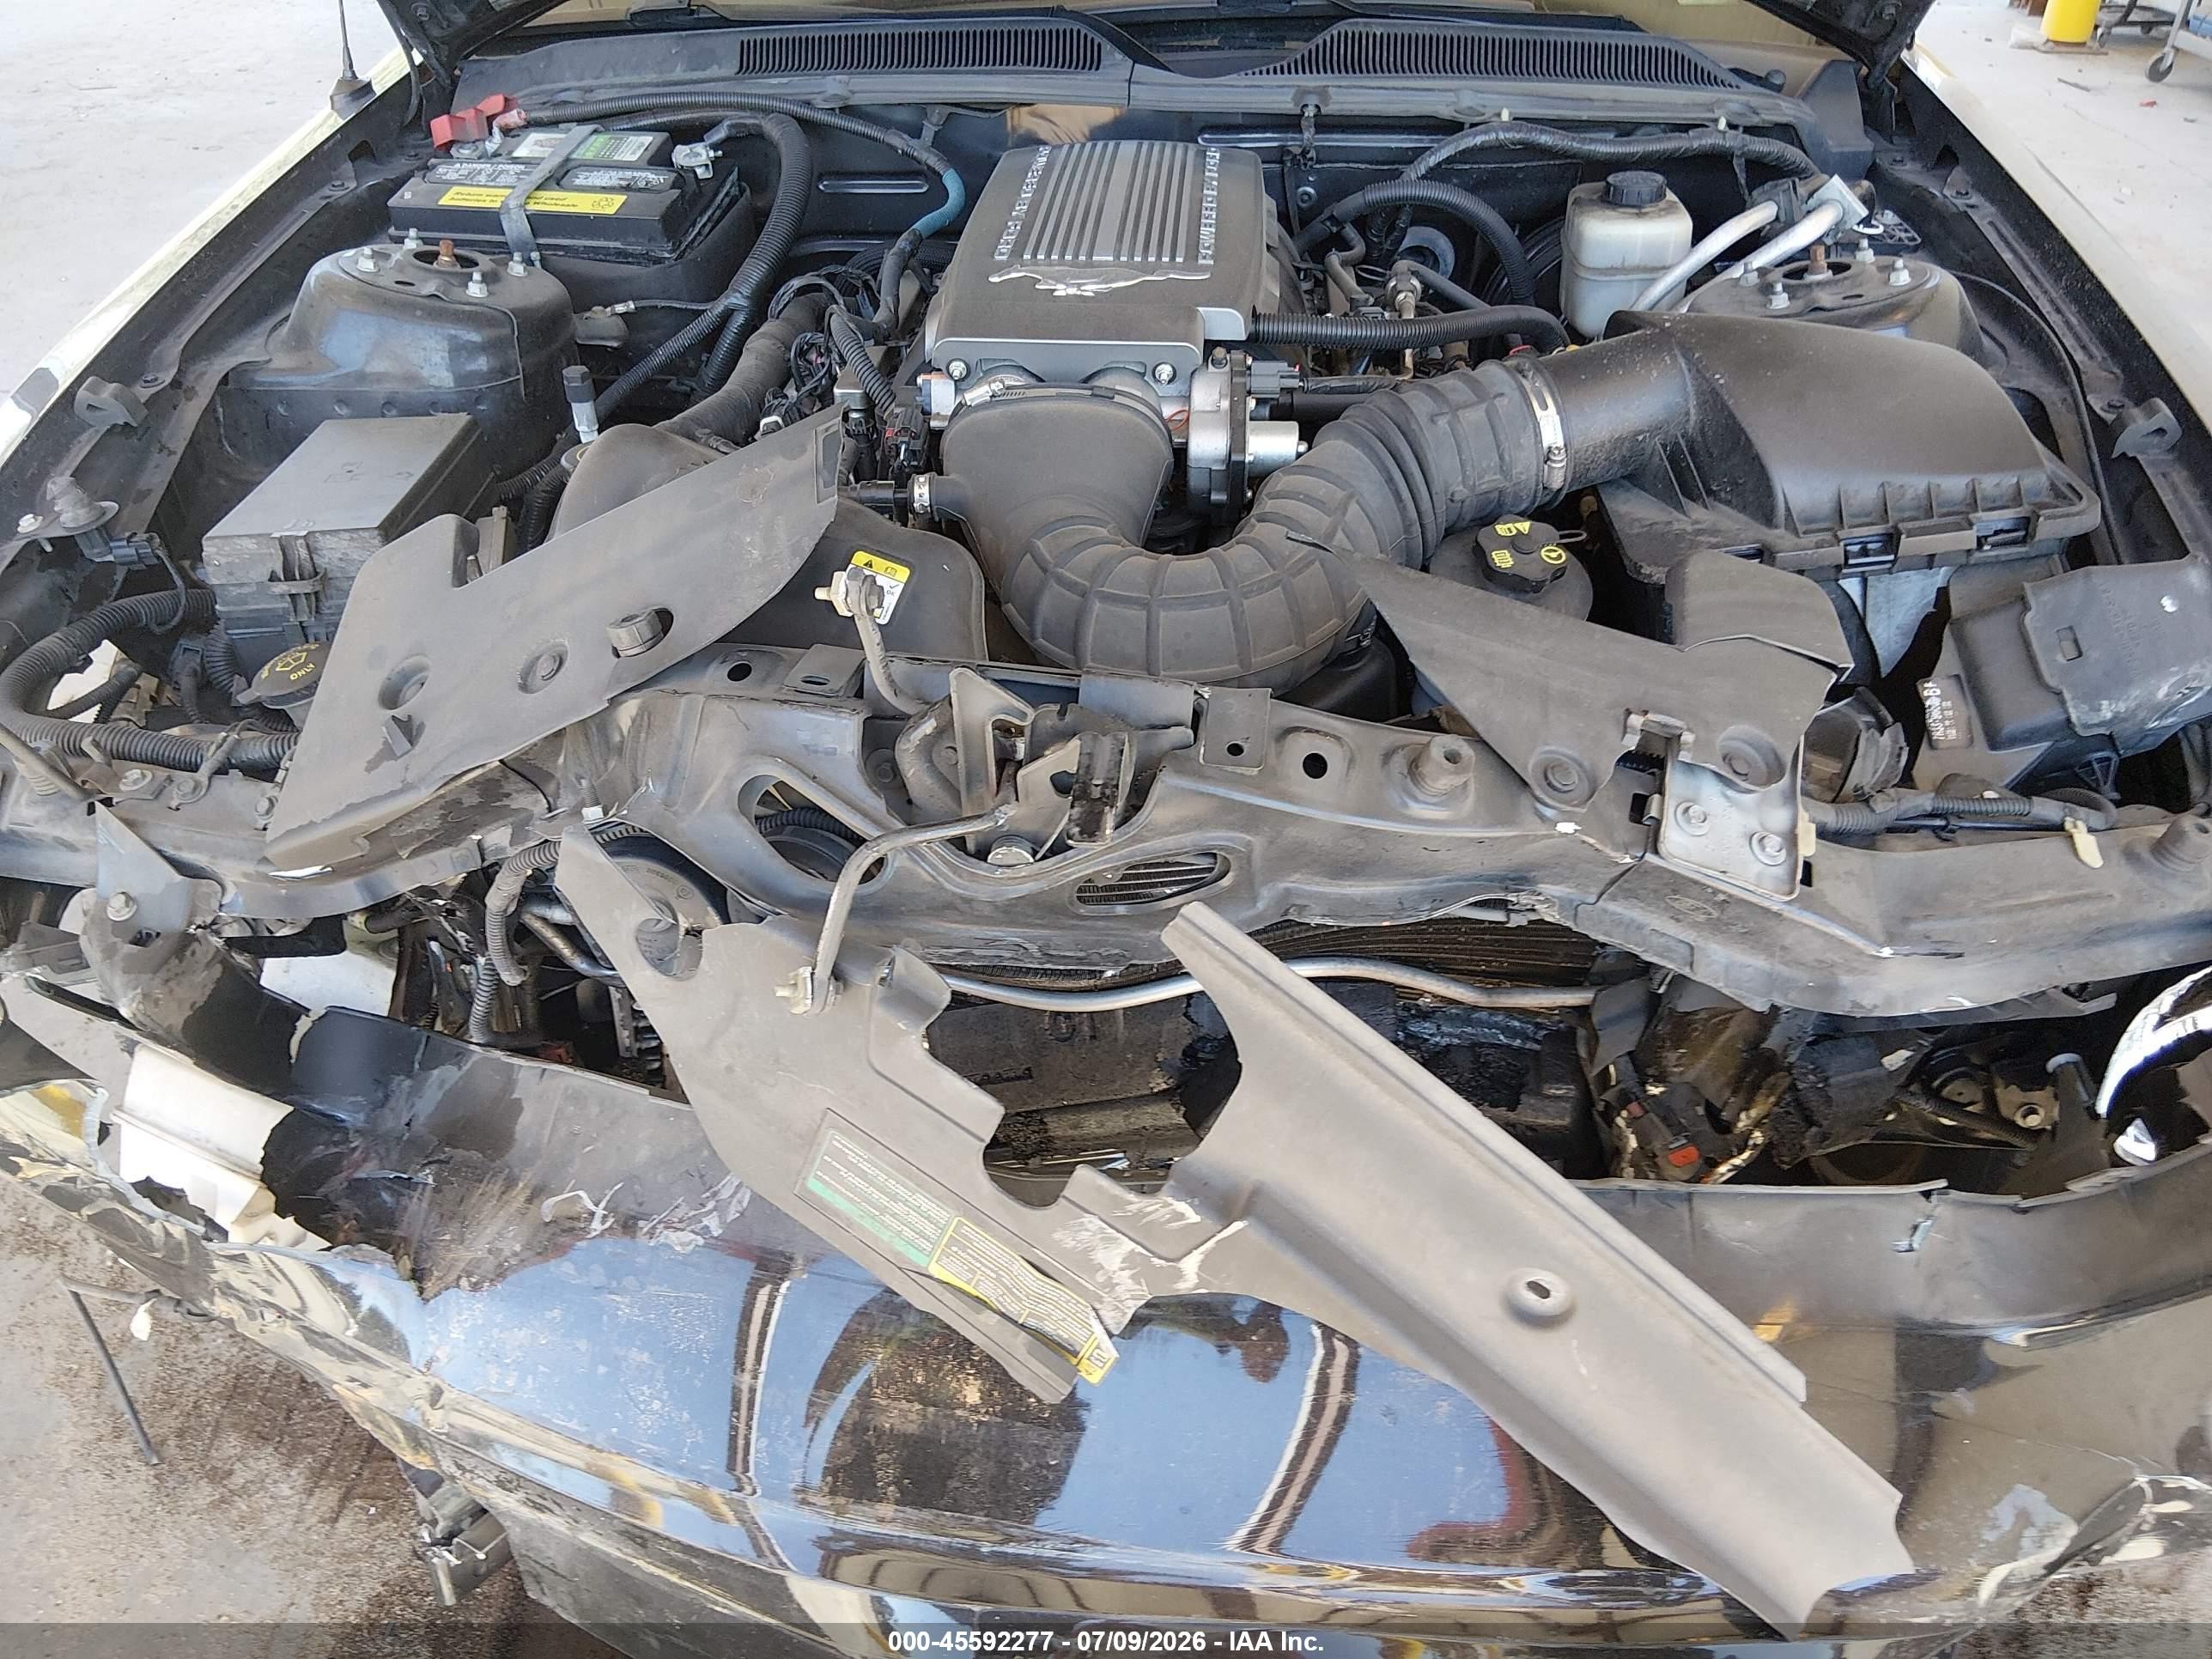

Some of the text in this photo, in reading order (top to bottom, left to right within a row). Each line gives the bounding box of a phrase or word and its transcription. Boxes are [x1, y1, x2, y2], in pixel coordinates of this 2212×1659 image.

[1012, 198, 1030, 219] BY
[1197, 147, 1220, 264] POWERED BY FORD
[994, 220, 1022, 260] FORD
[289, 662, 316, 680] ONLY
